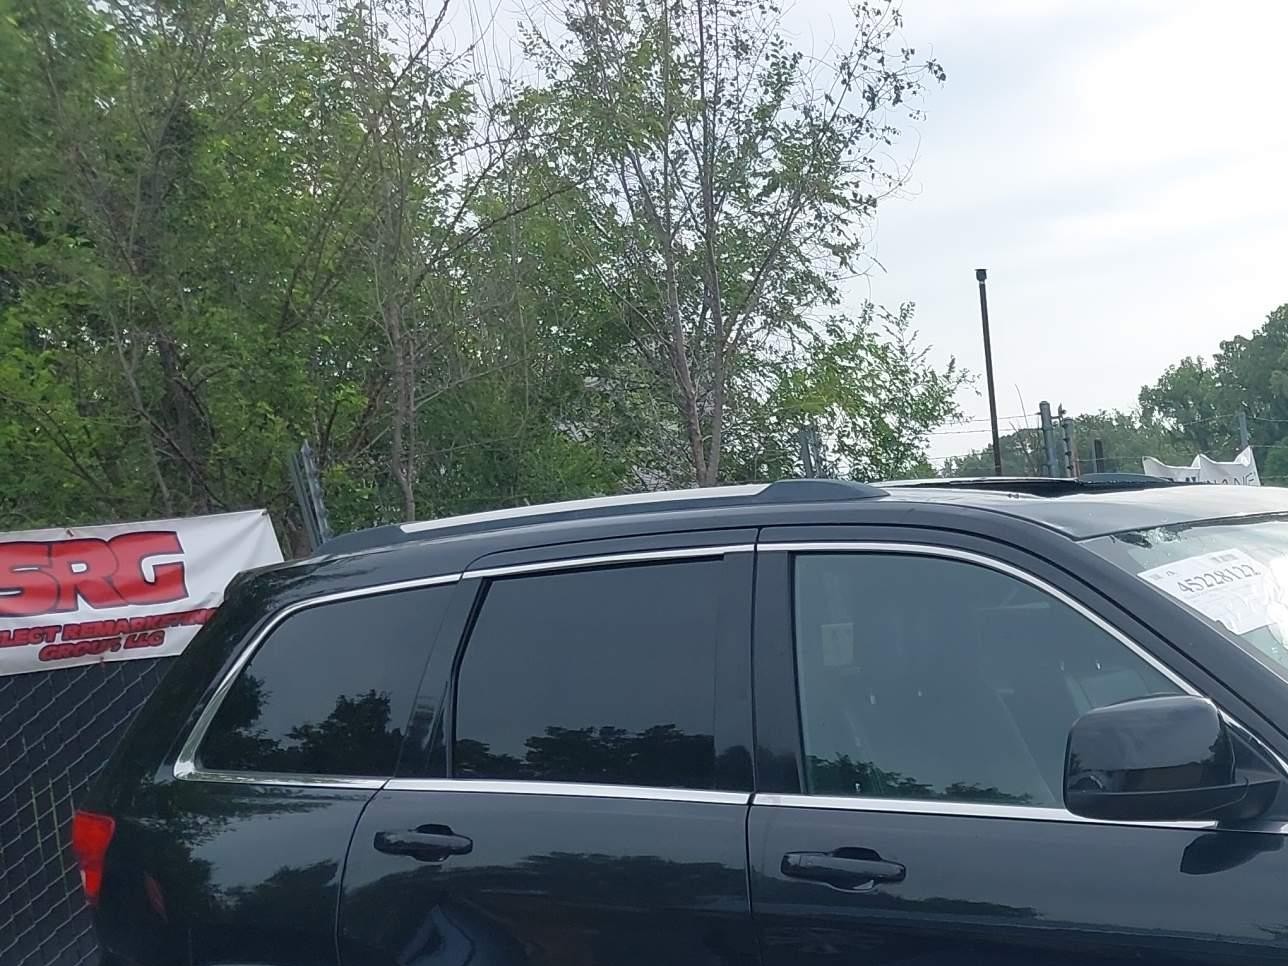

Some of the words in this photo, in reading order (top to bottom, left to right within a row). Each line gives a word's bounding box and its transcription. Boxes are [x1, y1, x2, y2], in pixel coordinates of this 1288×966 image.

[0, 530, 189, 617] SRG
[1176, 564, 1261, 593] 45228122
[124, 630, 165, 650] LLC
